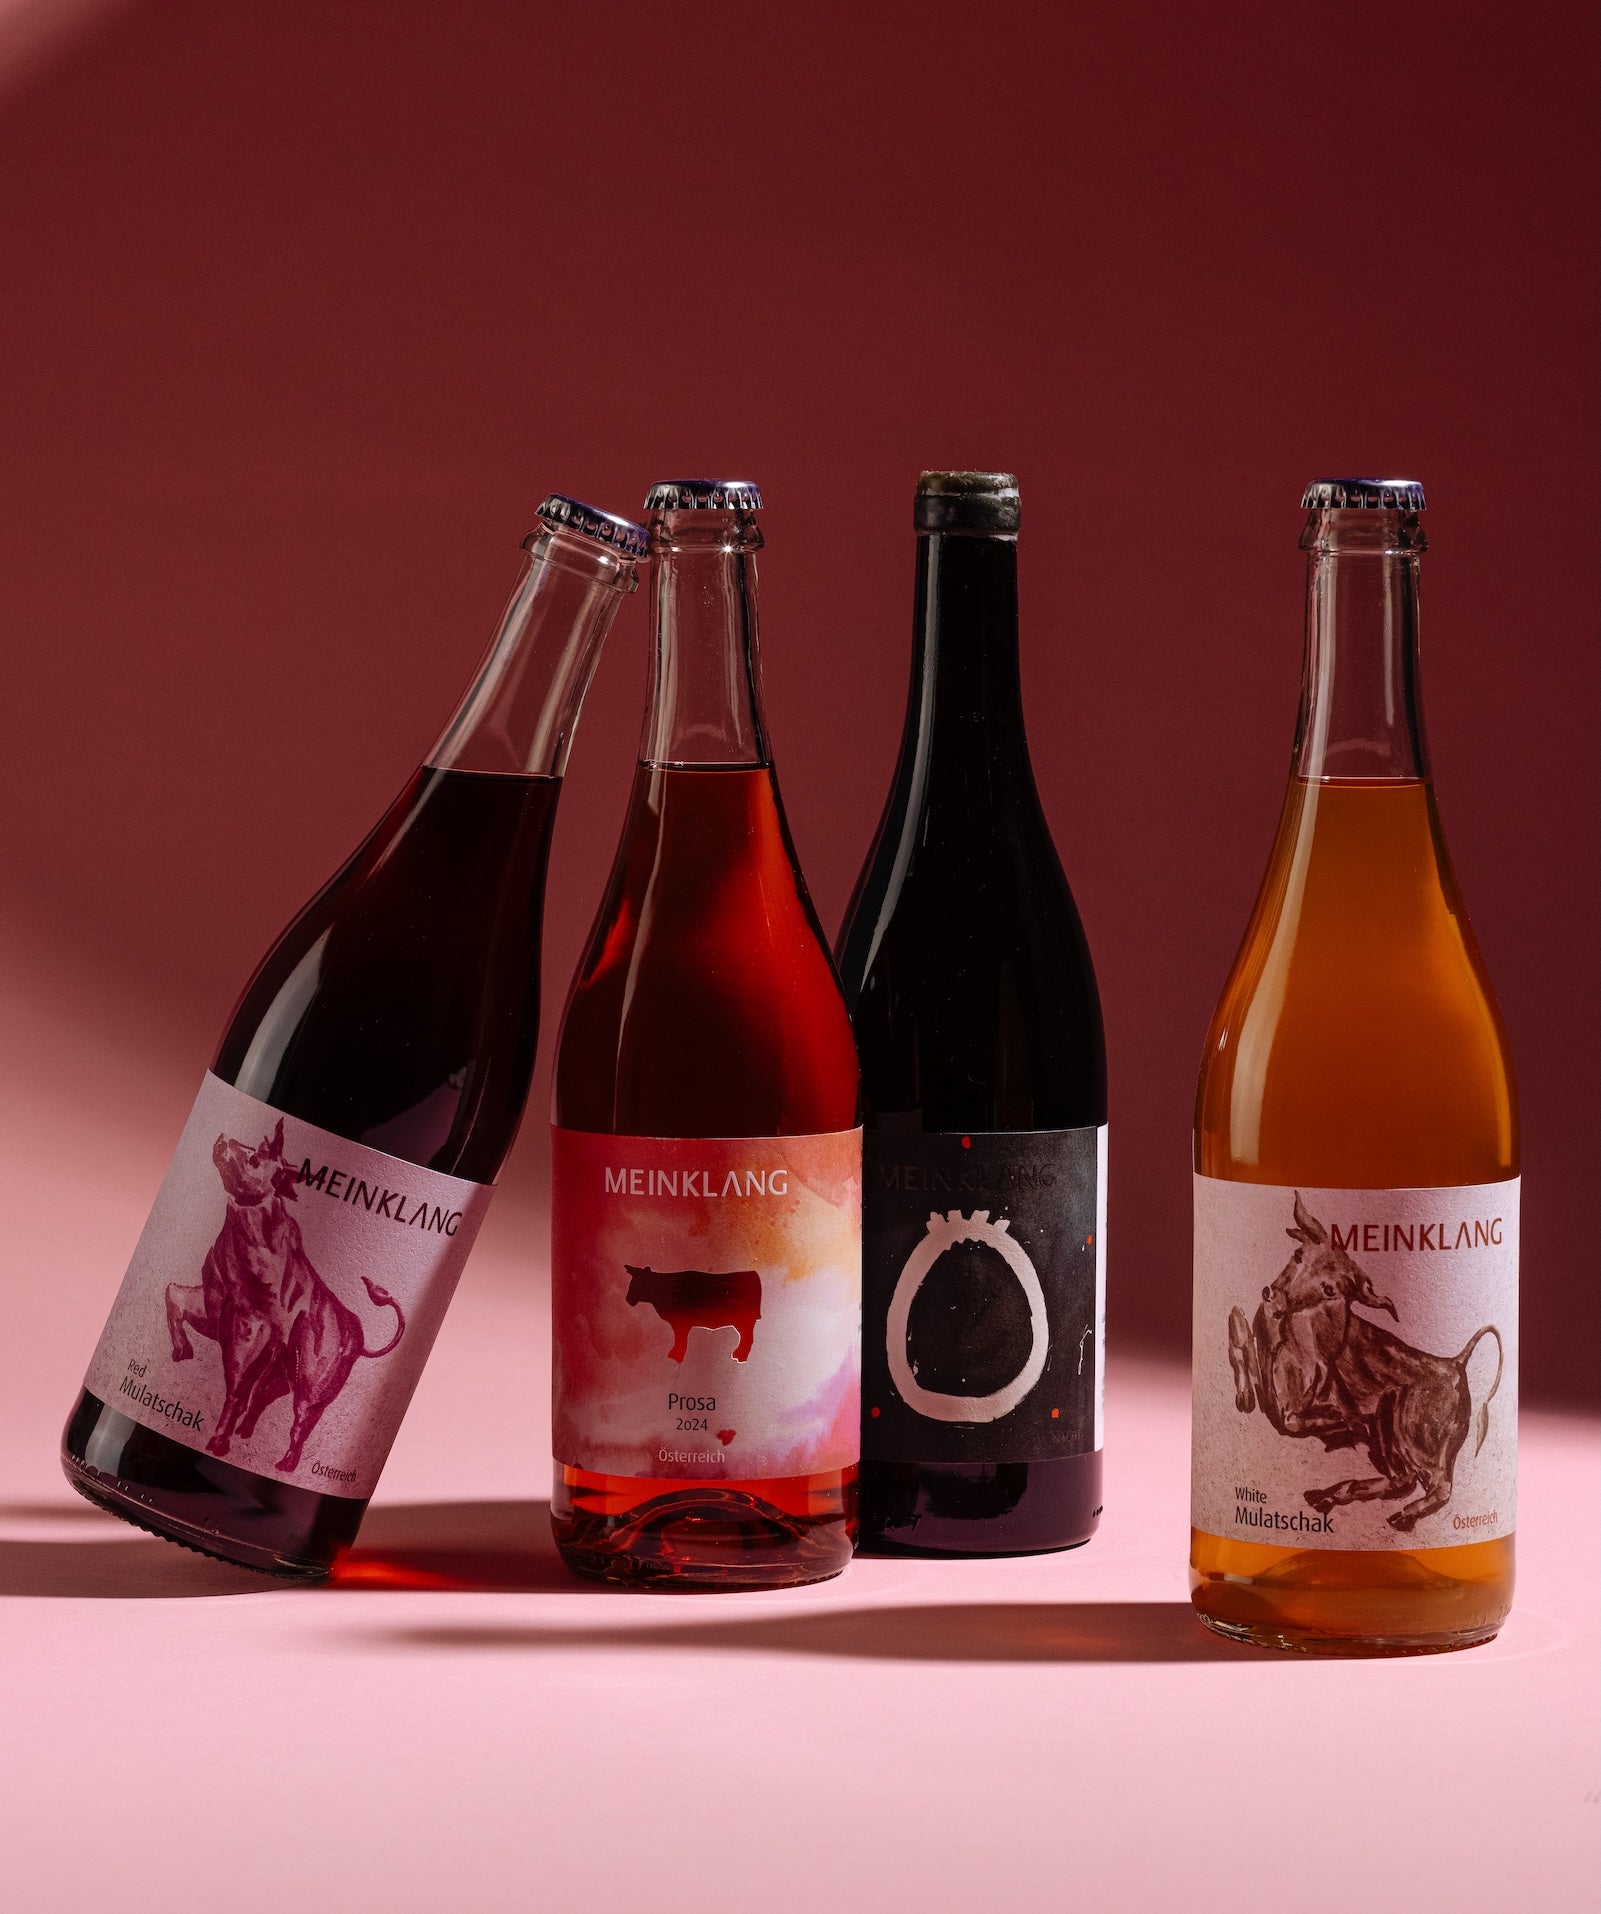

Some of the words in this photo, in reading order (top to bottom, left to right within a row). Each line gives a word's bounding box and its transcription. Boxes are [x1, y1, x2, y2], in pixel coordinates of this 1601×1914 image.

[604, 1167, 788, 1197] MEINKLANG
[298, 1158, 463, 1237] MEINKLANG
[1330, 1217, 1502, 1251] MEINKLANG
[127, 1358, 147, 1378] Red
[119, 1376, 205, 1432] Mulatschak
[668, 1393, 715, 1411] Prosa
[658, 1447, 725, 1464] Österreich
[311, 1461, 357, 1483] Österreich
[1234, 1486, 1267, 1504] White
[1235, 1506, 1334, 1533] Mulatschak
[1452, 1509, 1498, 1530] Österreich
